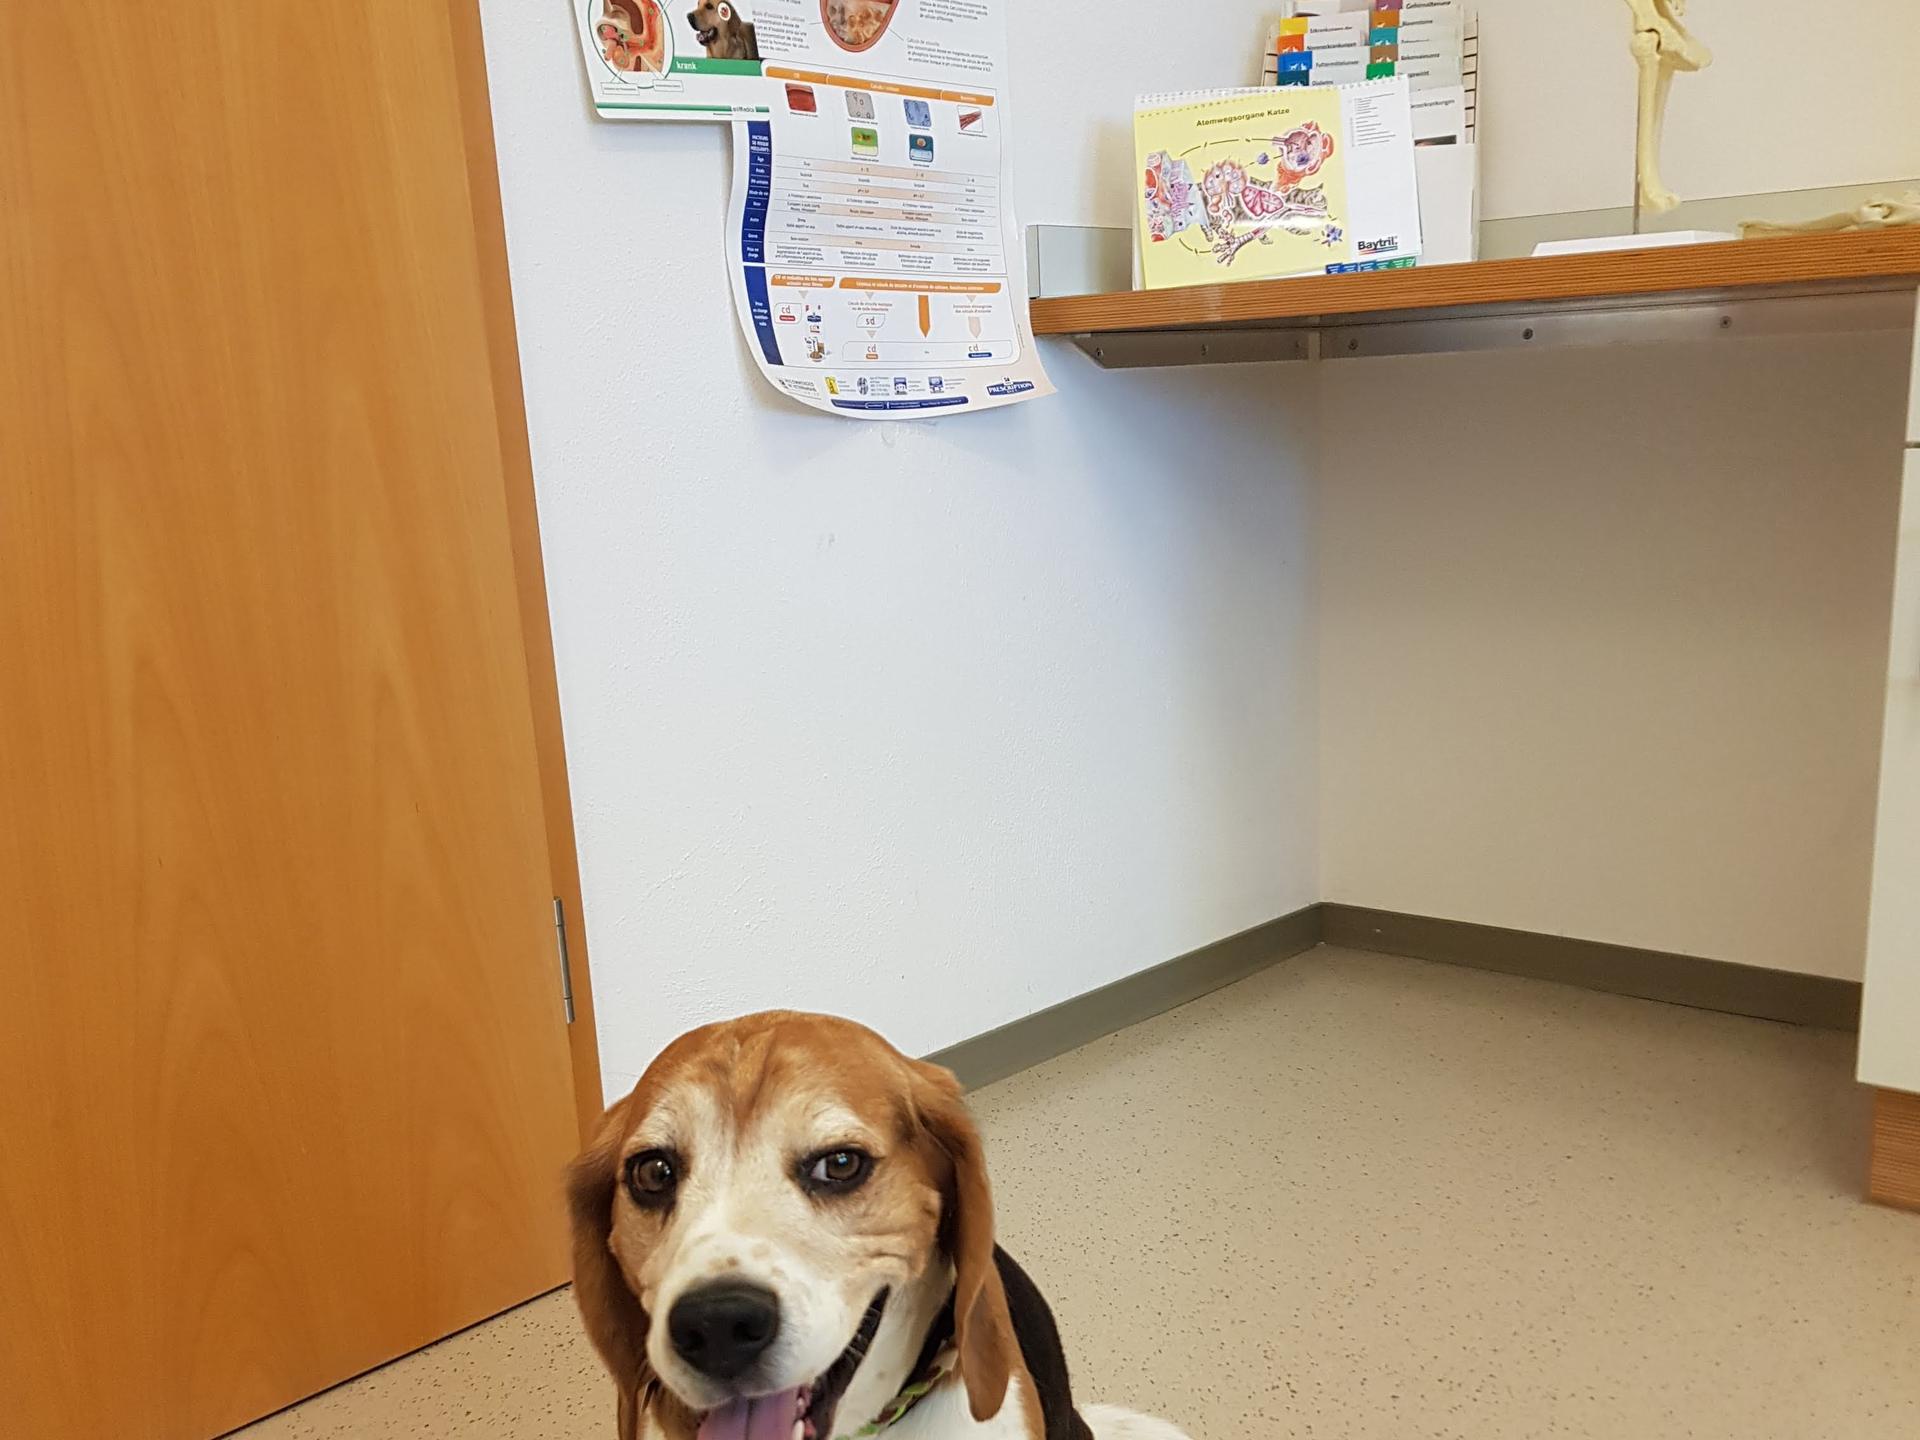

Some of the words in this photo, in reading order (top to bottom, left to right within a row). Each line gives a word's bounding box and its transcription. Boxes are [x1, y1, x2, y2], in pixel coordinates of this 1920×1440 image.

[676, 61, 697, 70] krank
[1196, 112, 1265, 127] Atemwegsorgane
[1267, 108, 1290, 116] Katze
[988, 382, 1032, 393] PRESCRIPTION
